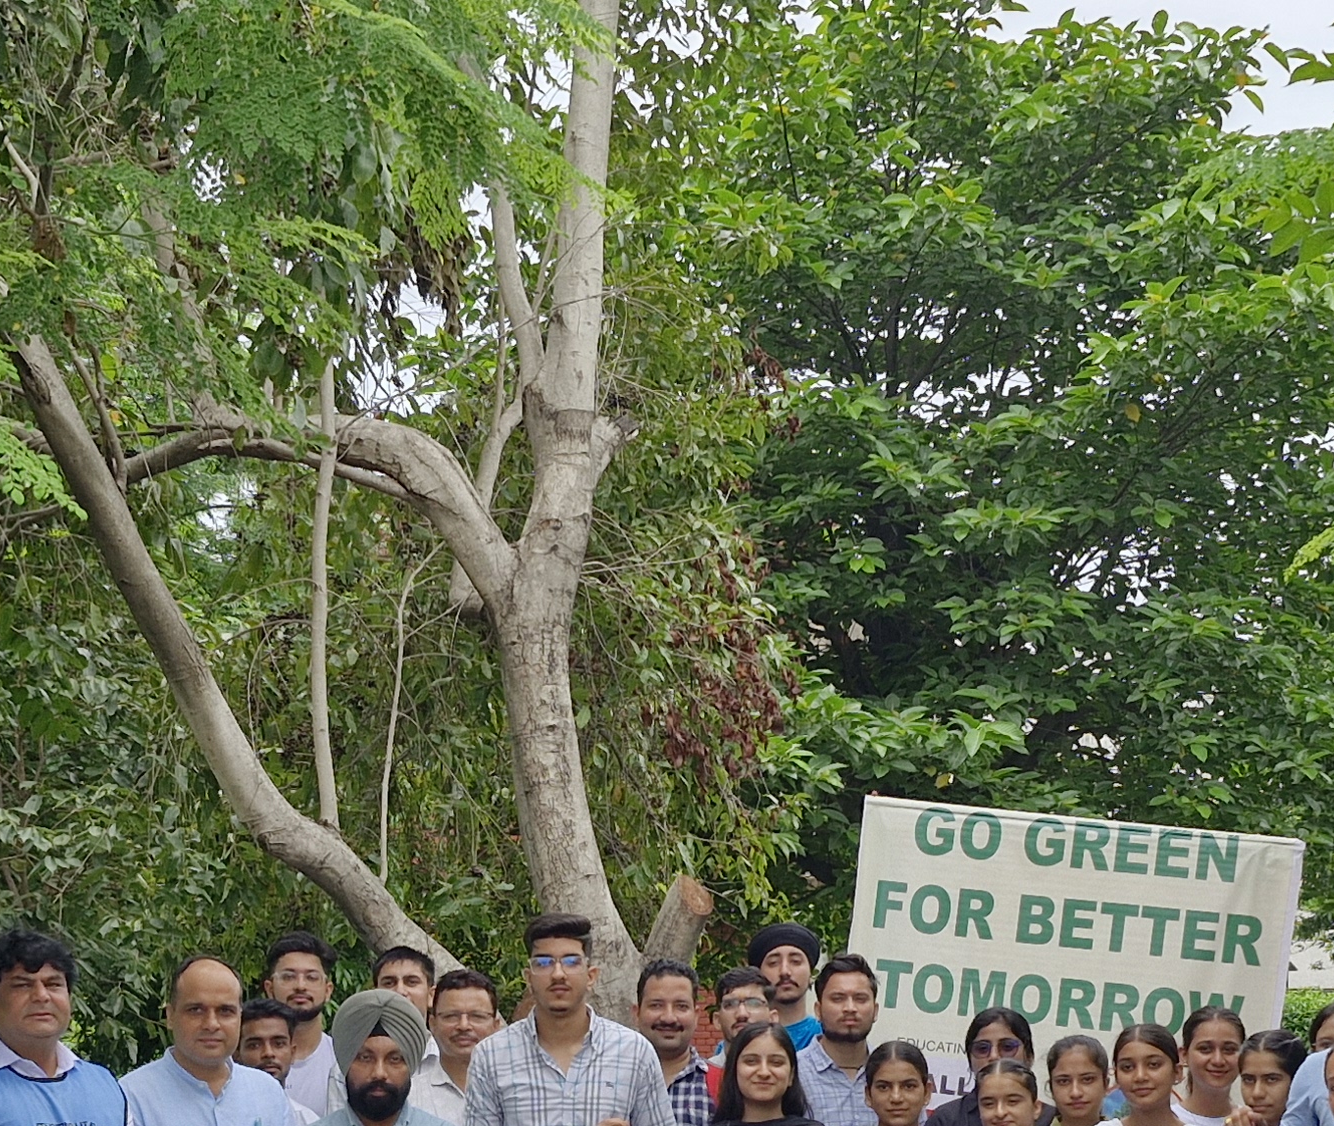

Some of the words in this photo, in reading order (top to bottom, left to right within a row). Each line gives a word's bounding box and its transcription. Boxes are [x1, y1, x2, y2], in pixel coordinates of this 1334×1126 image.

[914, 807, 1002, 860] GO
[1024, 817, 1240, 883] GREEN
[872, 879, 995, 941] FOR
[1015, 893, 1262, 966] BETTER
[897, 1036, 967, 1055] DUCATIN
